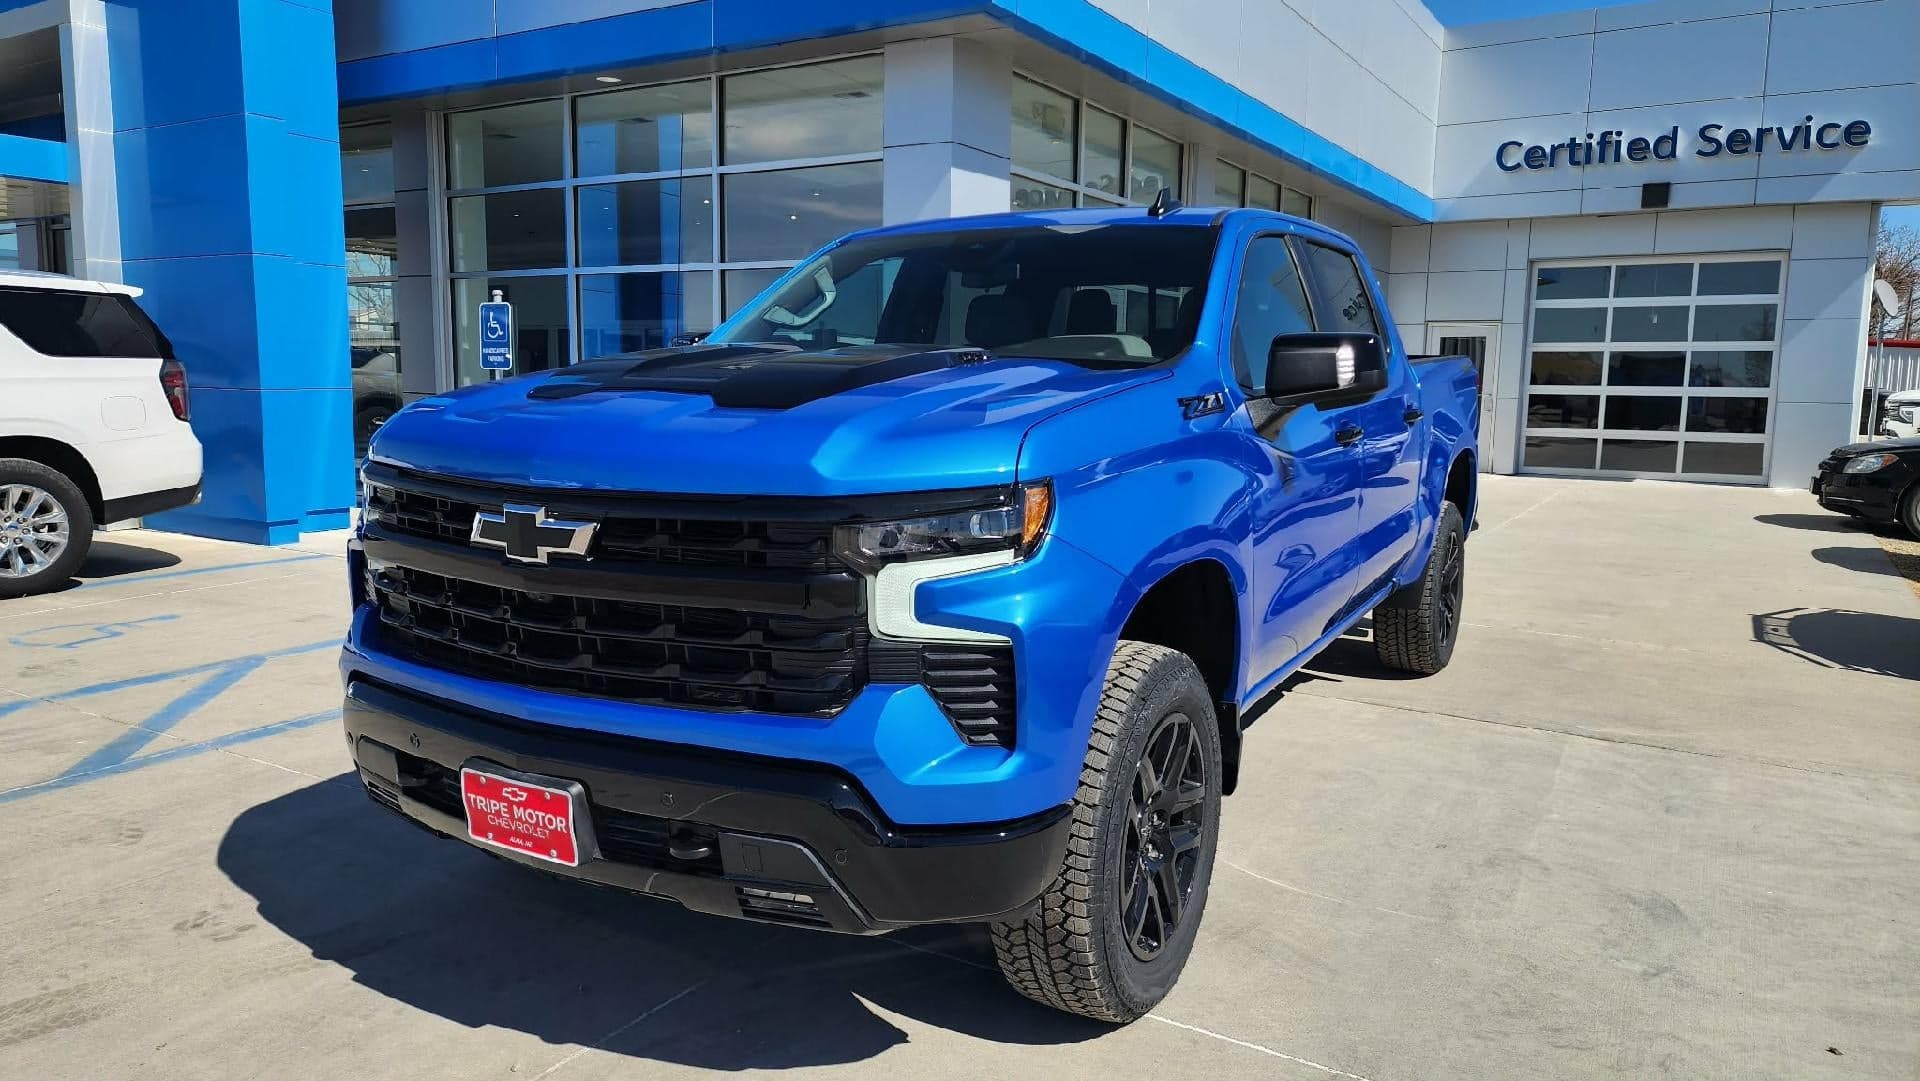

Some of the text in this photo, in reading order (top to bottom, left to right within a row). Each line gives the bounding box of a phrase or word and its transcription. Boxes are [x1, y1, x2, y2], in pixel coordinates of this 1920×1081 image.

[1495, 114, 1872, 172] Certified Service
[467, 792, 568, 834] TRIPE MOTOR
[487, 814, 550, 840] CHEVROLET
